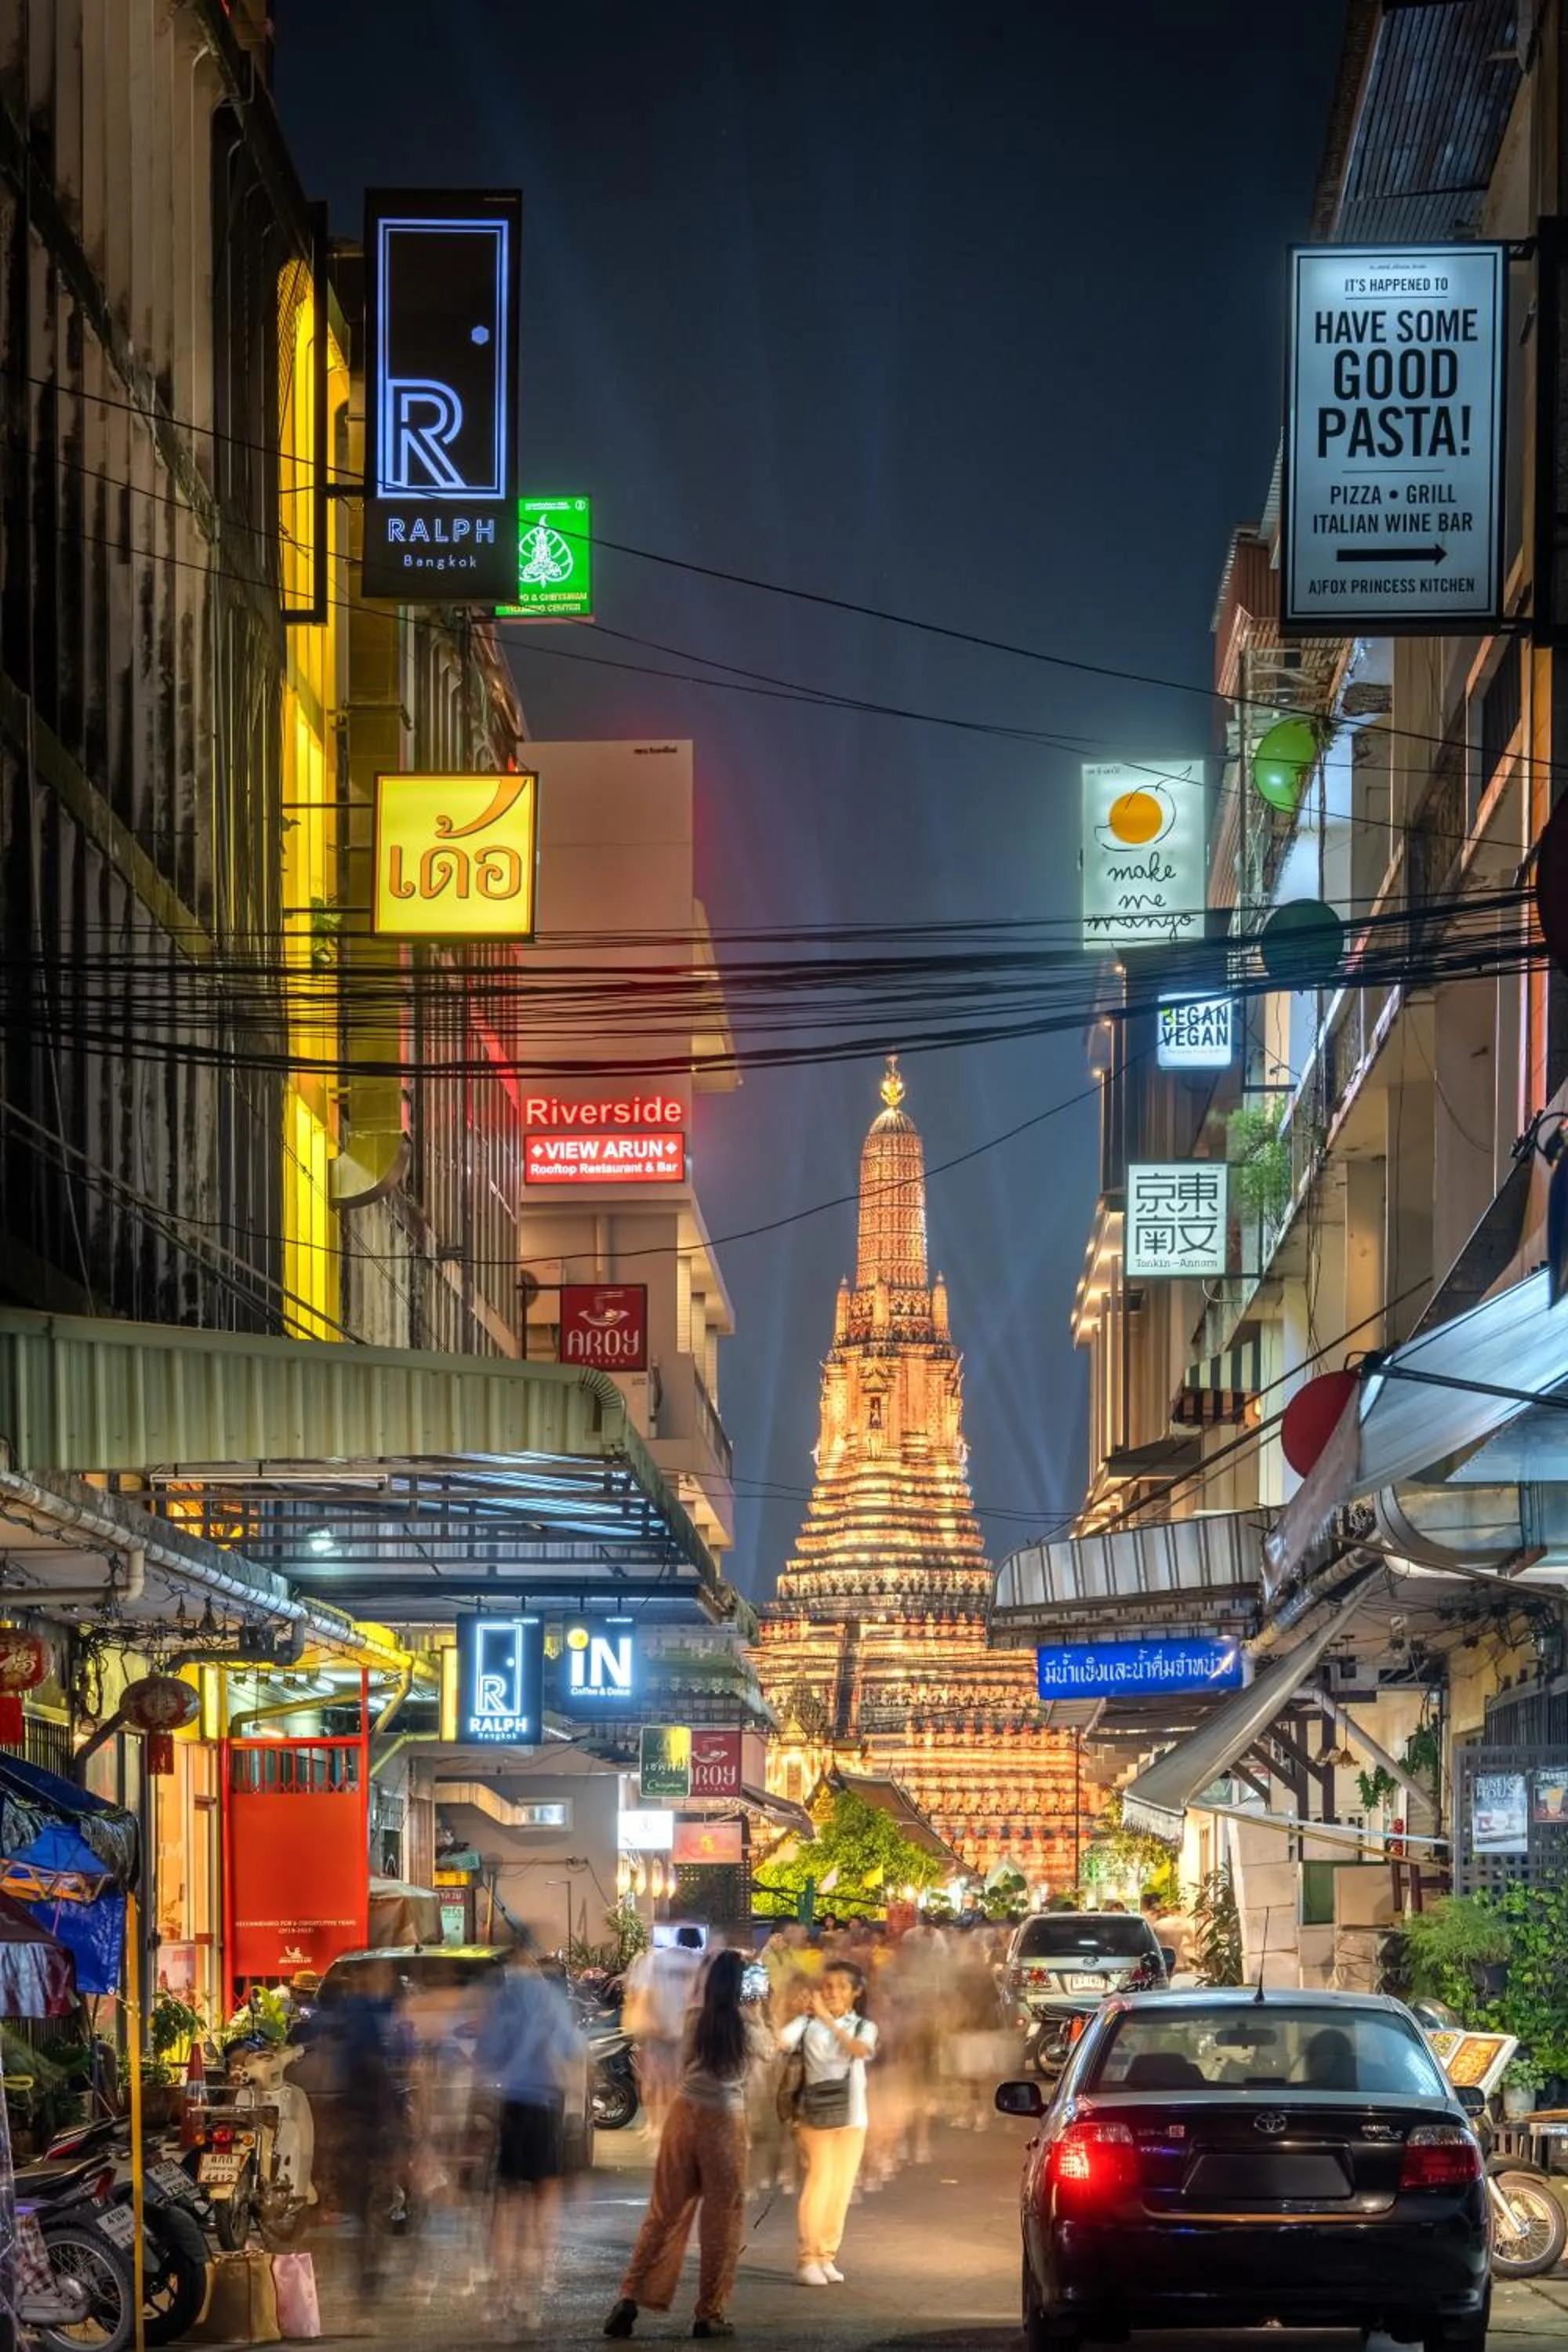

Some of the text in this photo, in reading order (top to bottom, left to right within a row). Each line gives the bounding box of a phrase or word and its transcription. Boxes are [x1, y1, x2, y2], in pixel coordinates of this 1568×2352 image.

[1345, 277, 1449, 292] IT'S HAPPENED TO
[1315, 309, 1479, 344] HAVE SOME
[1334, 349, 1458, 401] GOOD
[1318, 405, 1472, 458] PASTA!
[1330, 485, 1457, 505] PIZZA GRILL
[388, 518, 495, 543] RALPH
[1313, 512, 1473, 534] ITALIAN WINE BAR
[403, 554, 477, 571] Bangkok
[1352, 579, 1416, 593] PRINCESS
[1420, 577, 1475, 593] KITCHEN
[1107, 851, 1177, 882] make
[1118, 894, 1167, 909] me
[1162, 1026, 1229, 1046] VEGAN
[526, 1097, 681, 1124] Riverside
[546, 1140, 662, 1160] VIEW ARUN
[531, 1160, 677, 1176] Rooftop Restaurant & Bar
[568, 1329, 639, 1356] AROY
[470, 1717, 528, 1733] RALPH
[478, 1732, 517, 1741] Bangkok
[691, 1765, 736, 1785] ROY
